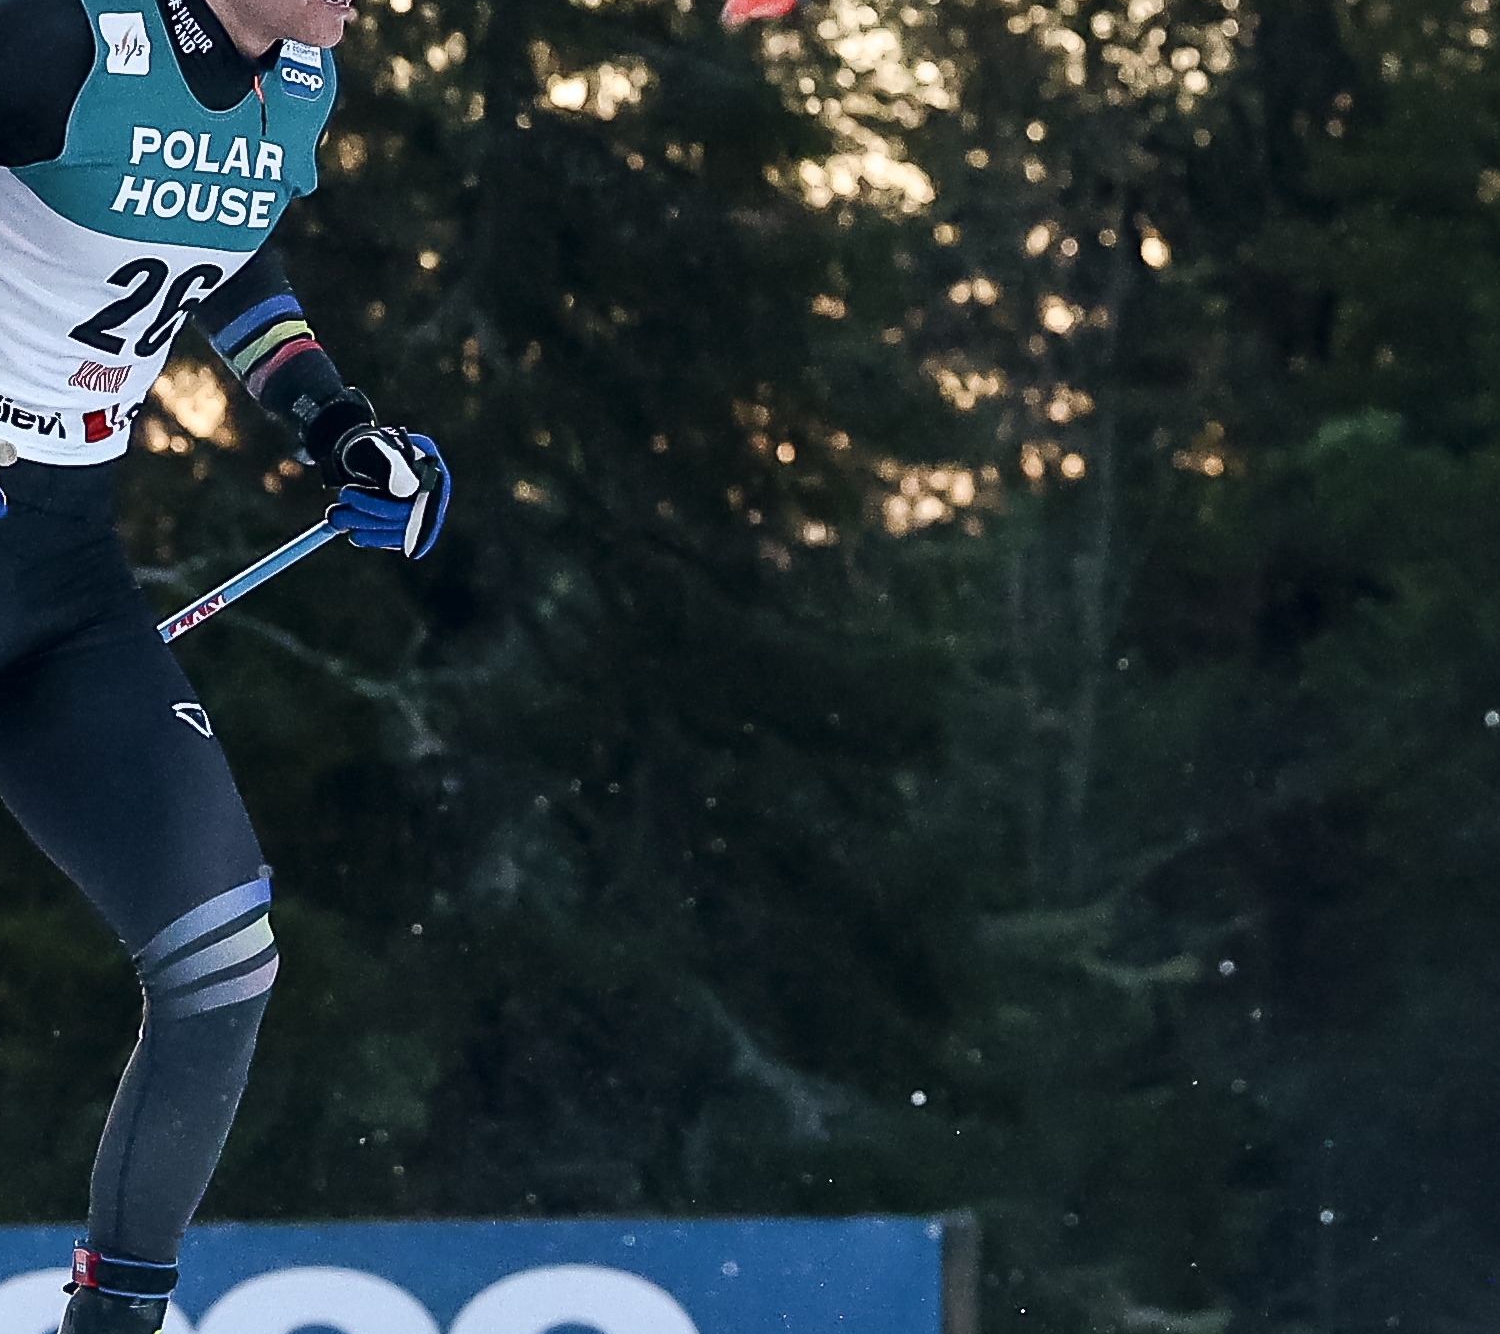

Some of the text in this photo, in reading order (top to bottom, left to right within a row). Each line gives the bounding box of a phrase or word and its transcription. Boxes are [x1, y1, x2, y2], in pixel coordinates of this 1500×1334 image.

[281, 67, 324, 92] coop
[129, 126, 284, 181] POLAR
[109, 175, 276, 228] HOUSE
[68, 257, 224, 357] 26
